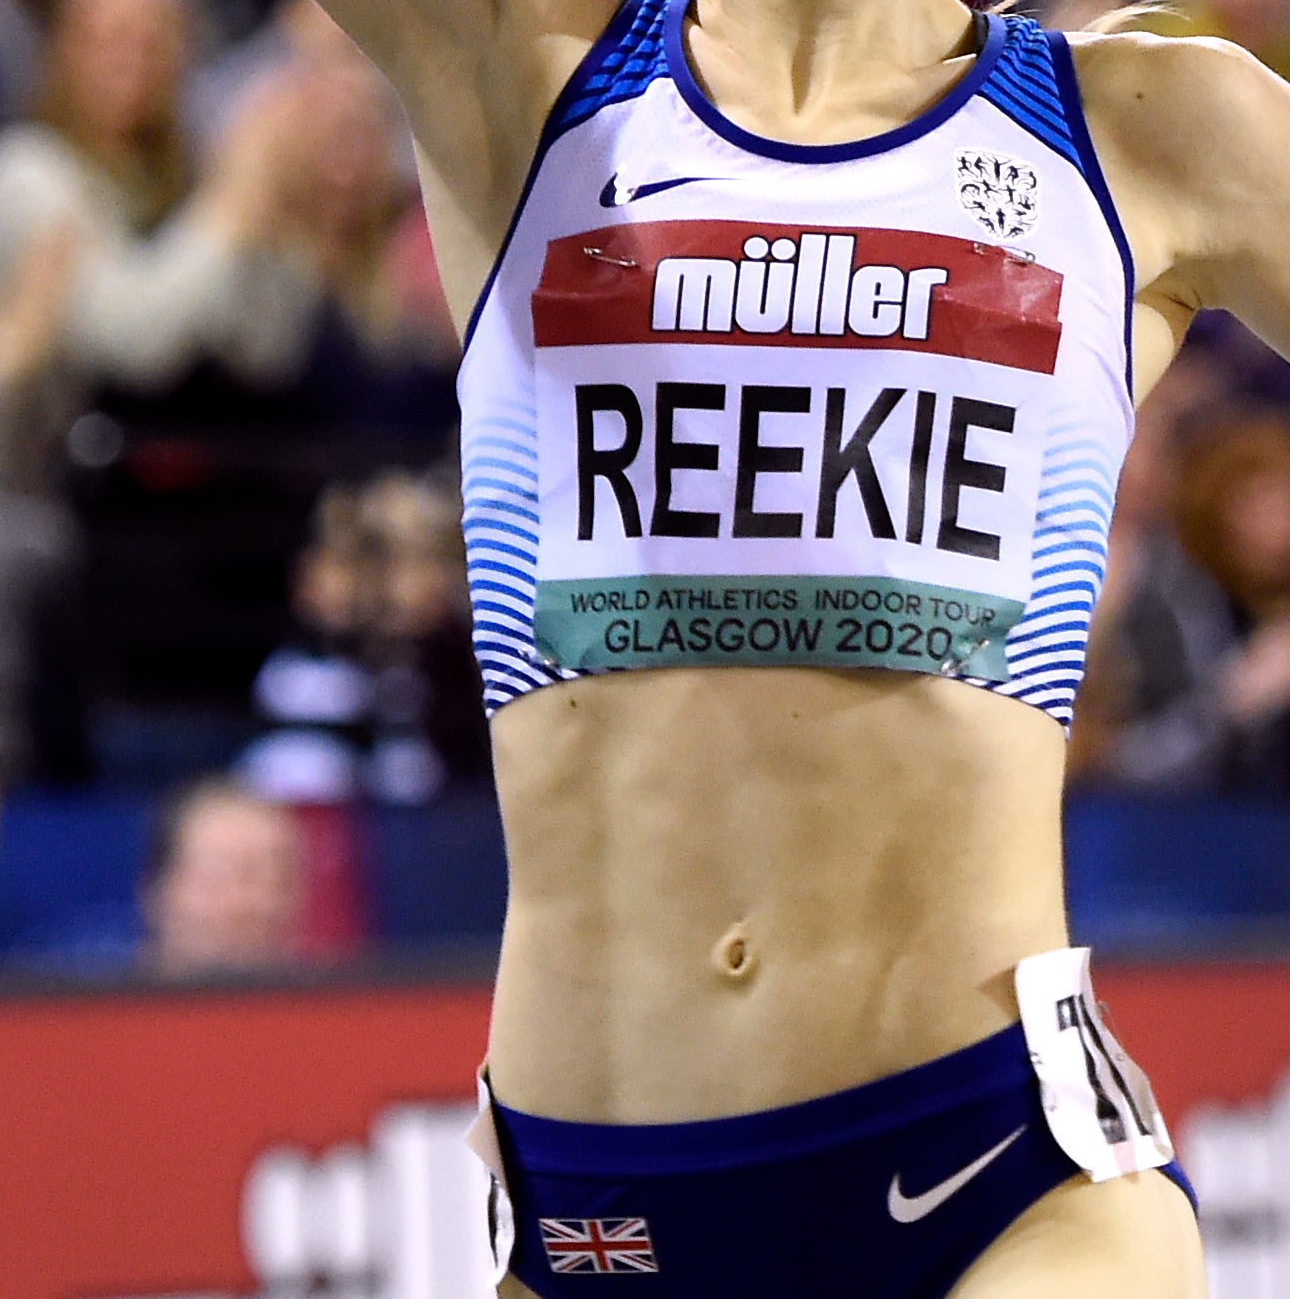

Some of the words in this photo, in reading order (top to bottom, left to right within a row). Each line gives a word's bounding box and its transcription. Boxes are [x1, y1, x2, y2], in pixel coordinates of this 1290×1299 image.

[651, 232, 949, 340] müller
[574, 381, 1017, 560] REEKIE
[570, 589, 650, 613] WORLD
[656, 587, 797, 610] ATHLETICS
[816, 589, 921, 616] INDOOR
[930, 597, 995, 626] TOUR
[604, 617, 823, 653] GLASGOW
[836, 618, 953, 661] 2020
